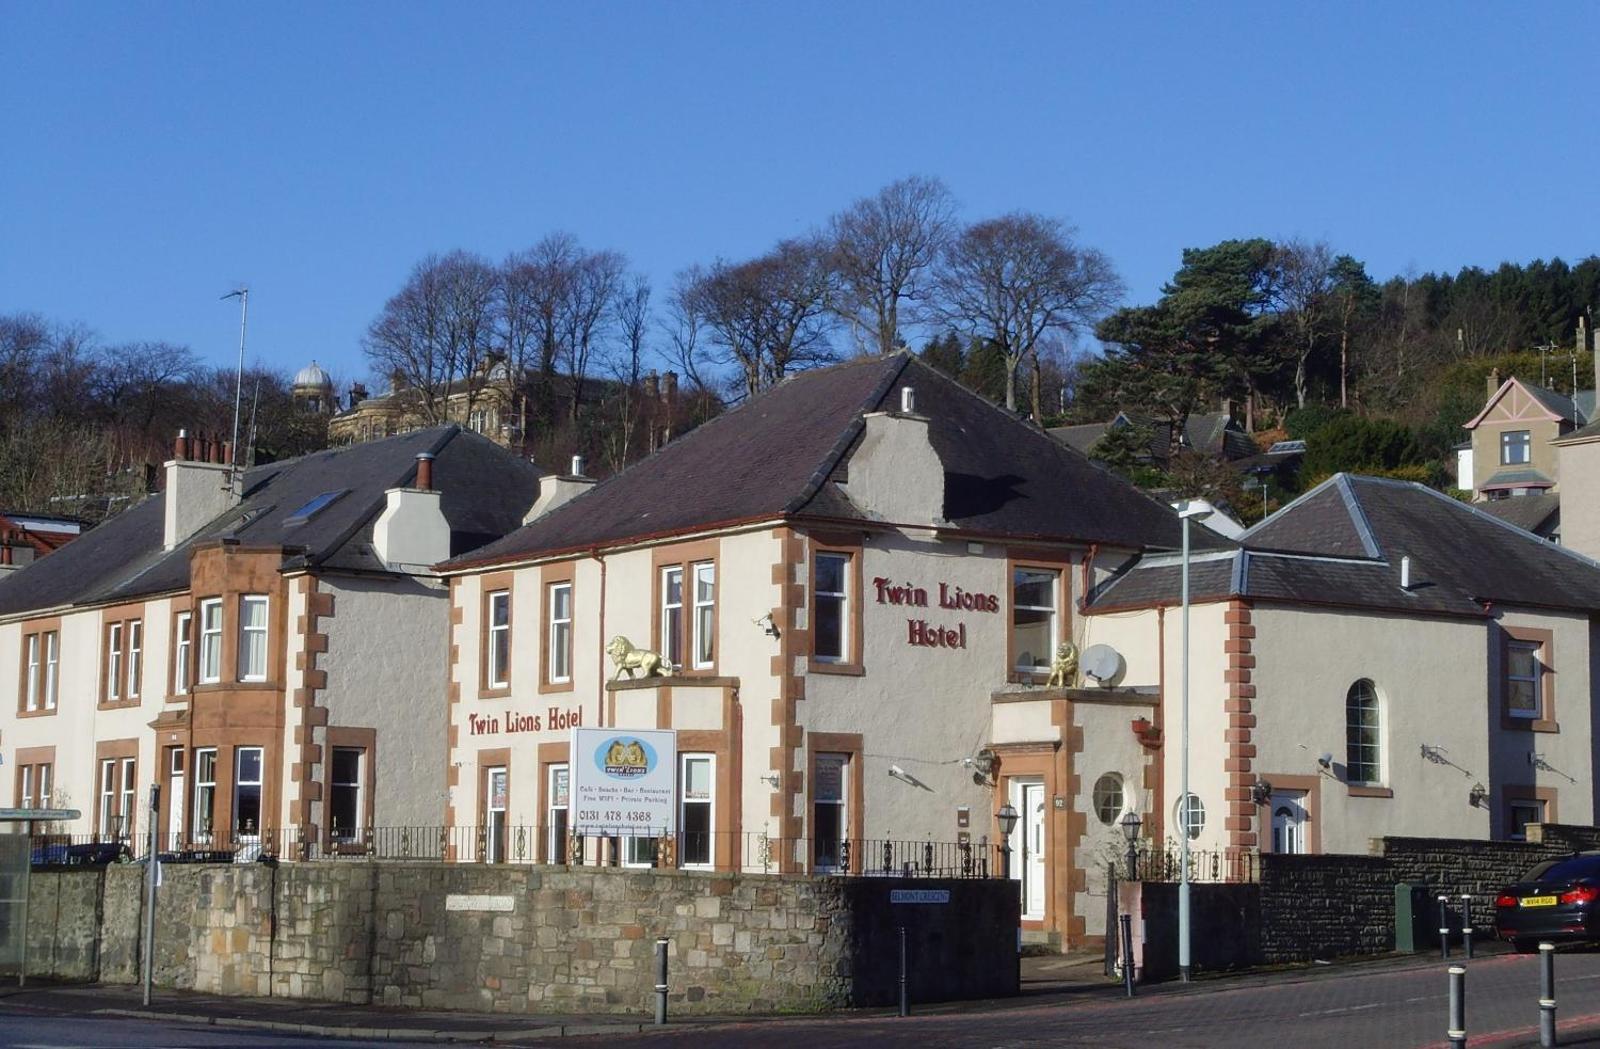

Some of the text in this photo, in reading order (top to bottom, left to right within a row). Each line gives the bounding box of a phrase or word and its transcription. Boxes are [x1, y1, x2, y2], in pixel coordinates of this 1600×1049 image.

[873, 576, 1000, 614] Twin Lions
[907, 619, 966, 649] Hotel
[469, 704, 582, 735] Twin Lions Hotel
[579, 810, 652, 821] 0131 478 4368
